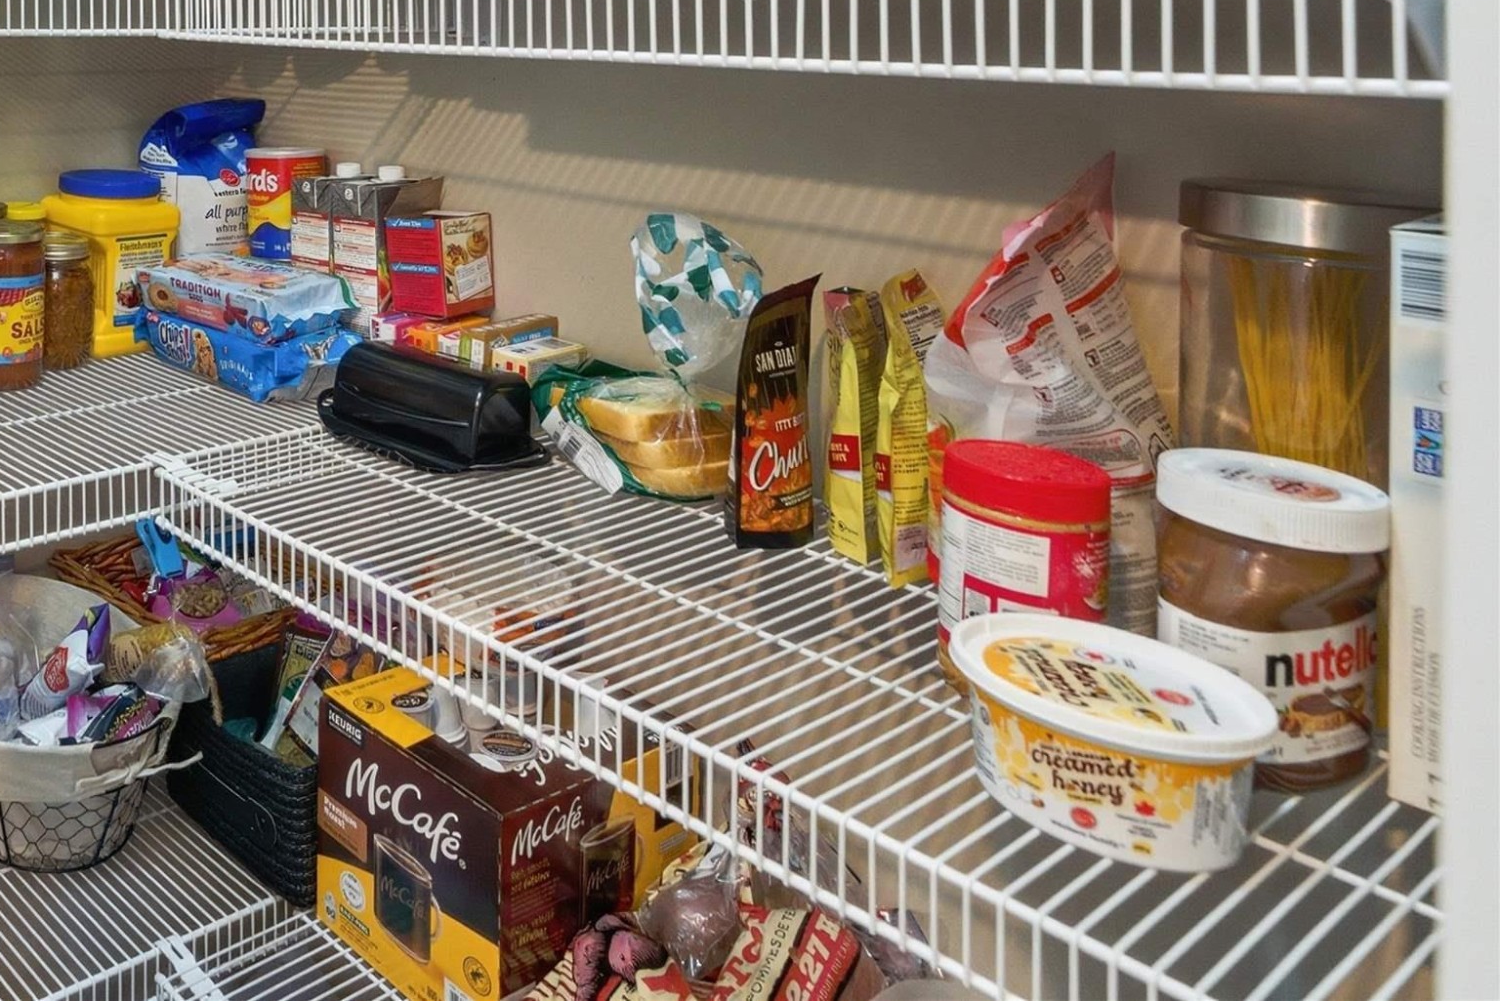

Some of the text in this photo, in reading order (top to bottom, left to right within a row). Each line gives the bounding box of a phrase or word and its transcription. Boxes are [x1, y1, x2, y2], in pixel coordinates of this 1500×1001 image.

[250, 168, 279, 193] rd's
[205, 204, 222, 220] all
[169, 277, 222, 301] TRADITION
[755, 351, 775, 374] SAN
[328, 709, 363, 741] KEURIG
[1031, 748, 1136, 779] creamed
[1052, 769, 1126, 806] honey
[323, 795, 358, 830] Premium
[345, 756, 463, 864] McCafé
[510, 795, 585, 867] McCafé
